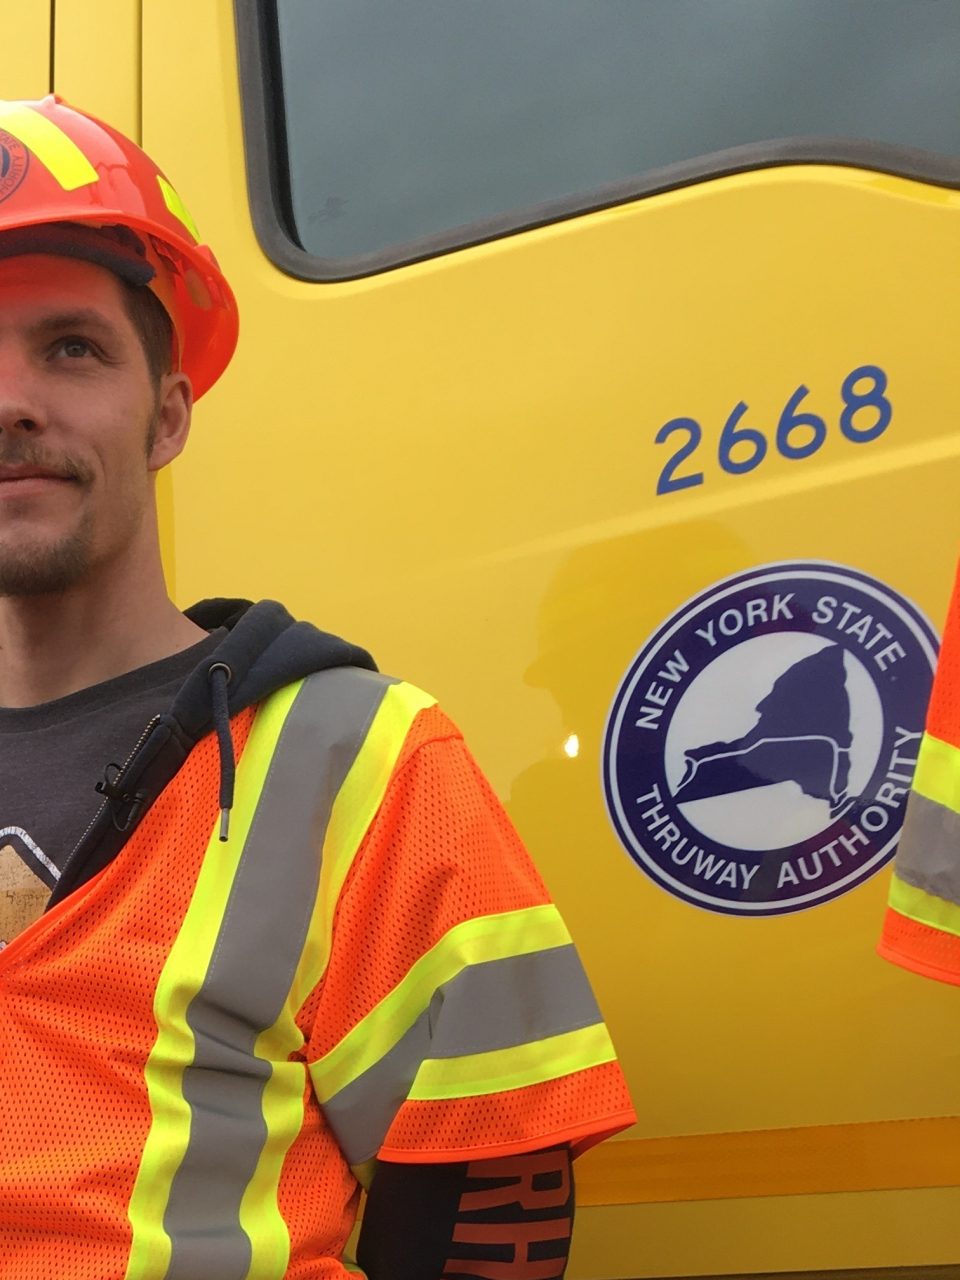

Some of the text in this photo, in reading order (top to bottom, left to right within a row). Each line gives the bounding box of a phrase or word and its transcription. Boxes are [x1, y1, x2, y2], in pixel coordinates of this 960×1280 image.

[654, 364, 893, 496] 2668
[635, 592, 907, 730] NEW YORK STATE
[636, 725, 924, 890] THRUWAY AUTHORITY
